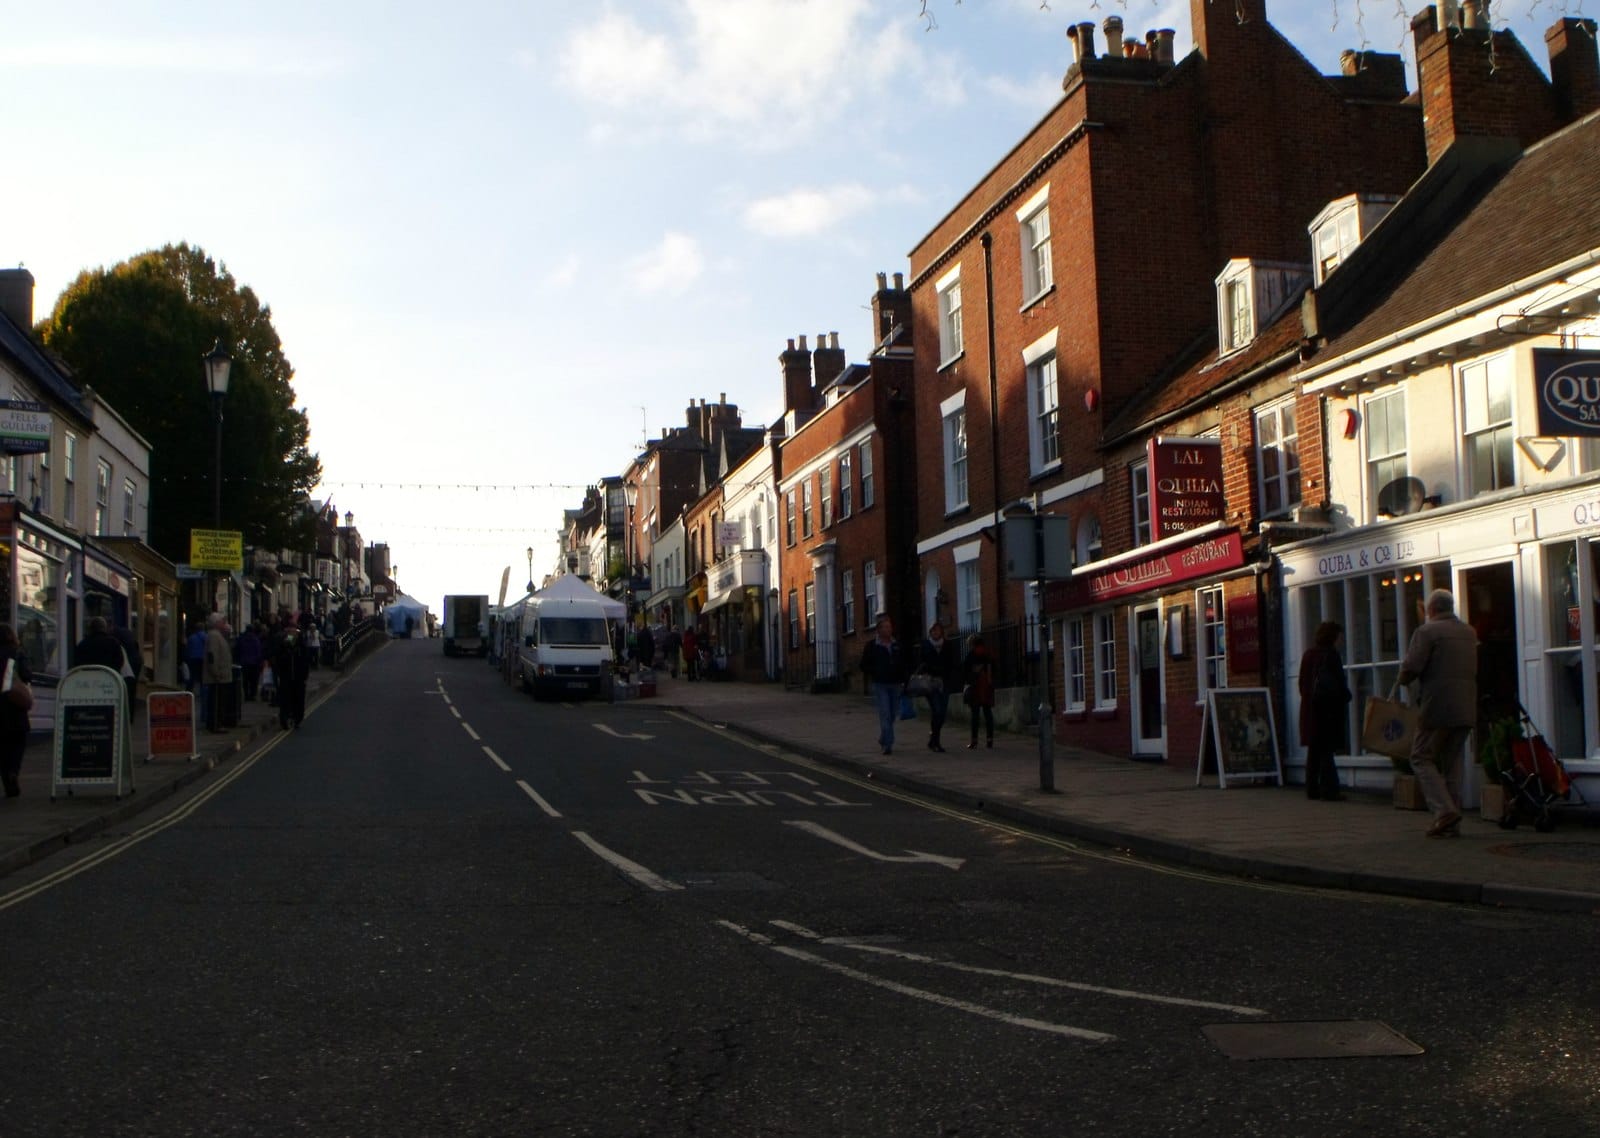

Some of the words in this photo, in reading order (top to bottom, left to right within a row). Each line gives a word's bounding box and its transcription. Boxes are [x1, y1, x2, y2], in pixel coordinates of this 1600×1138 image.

[24, 403, 41, 411] SALE
[11, 412, 38, 422] FELLS
[1, 421, 48, 433] GULLIVER
[1173, 449, 1203, 465] LAL
[1157, 477, 1220, 495] QUILLA
[1174, 499, 1210, 508] INDIAN
[1162, 507, 1219, 517] RESTAURANT
[199, 547, 240, 556] Christmas
[1181, 541, 1230, 567] RESTAURANT
[1319, 554, 1353, 575] QUBA
[1360, 550, 1369, 567] &
[1088, 572, 1111, 594] LAL
[1113, 556, 1171, 586] QUILLA
[626, 770, 820, 786] LEFT
[633, 789, 873, 806] TURN
